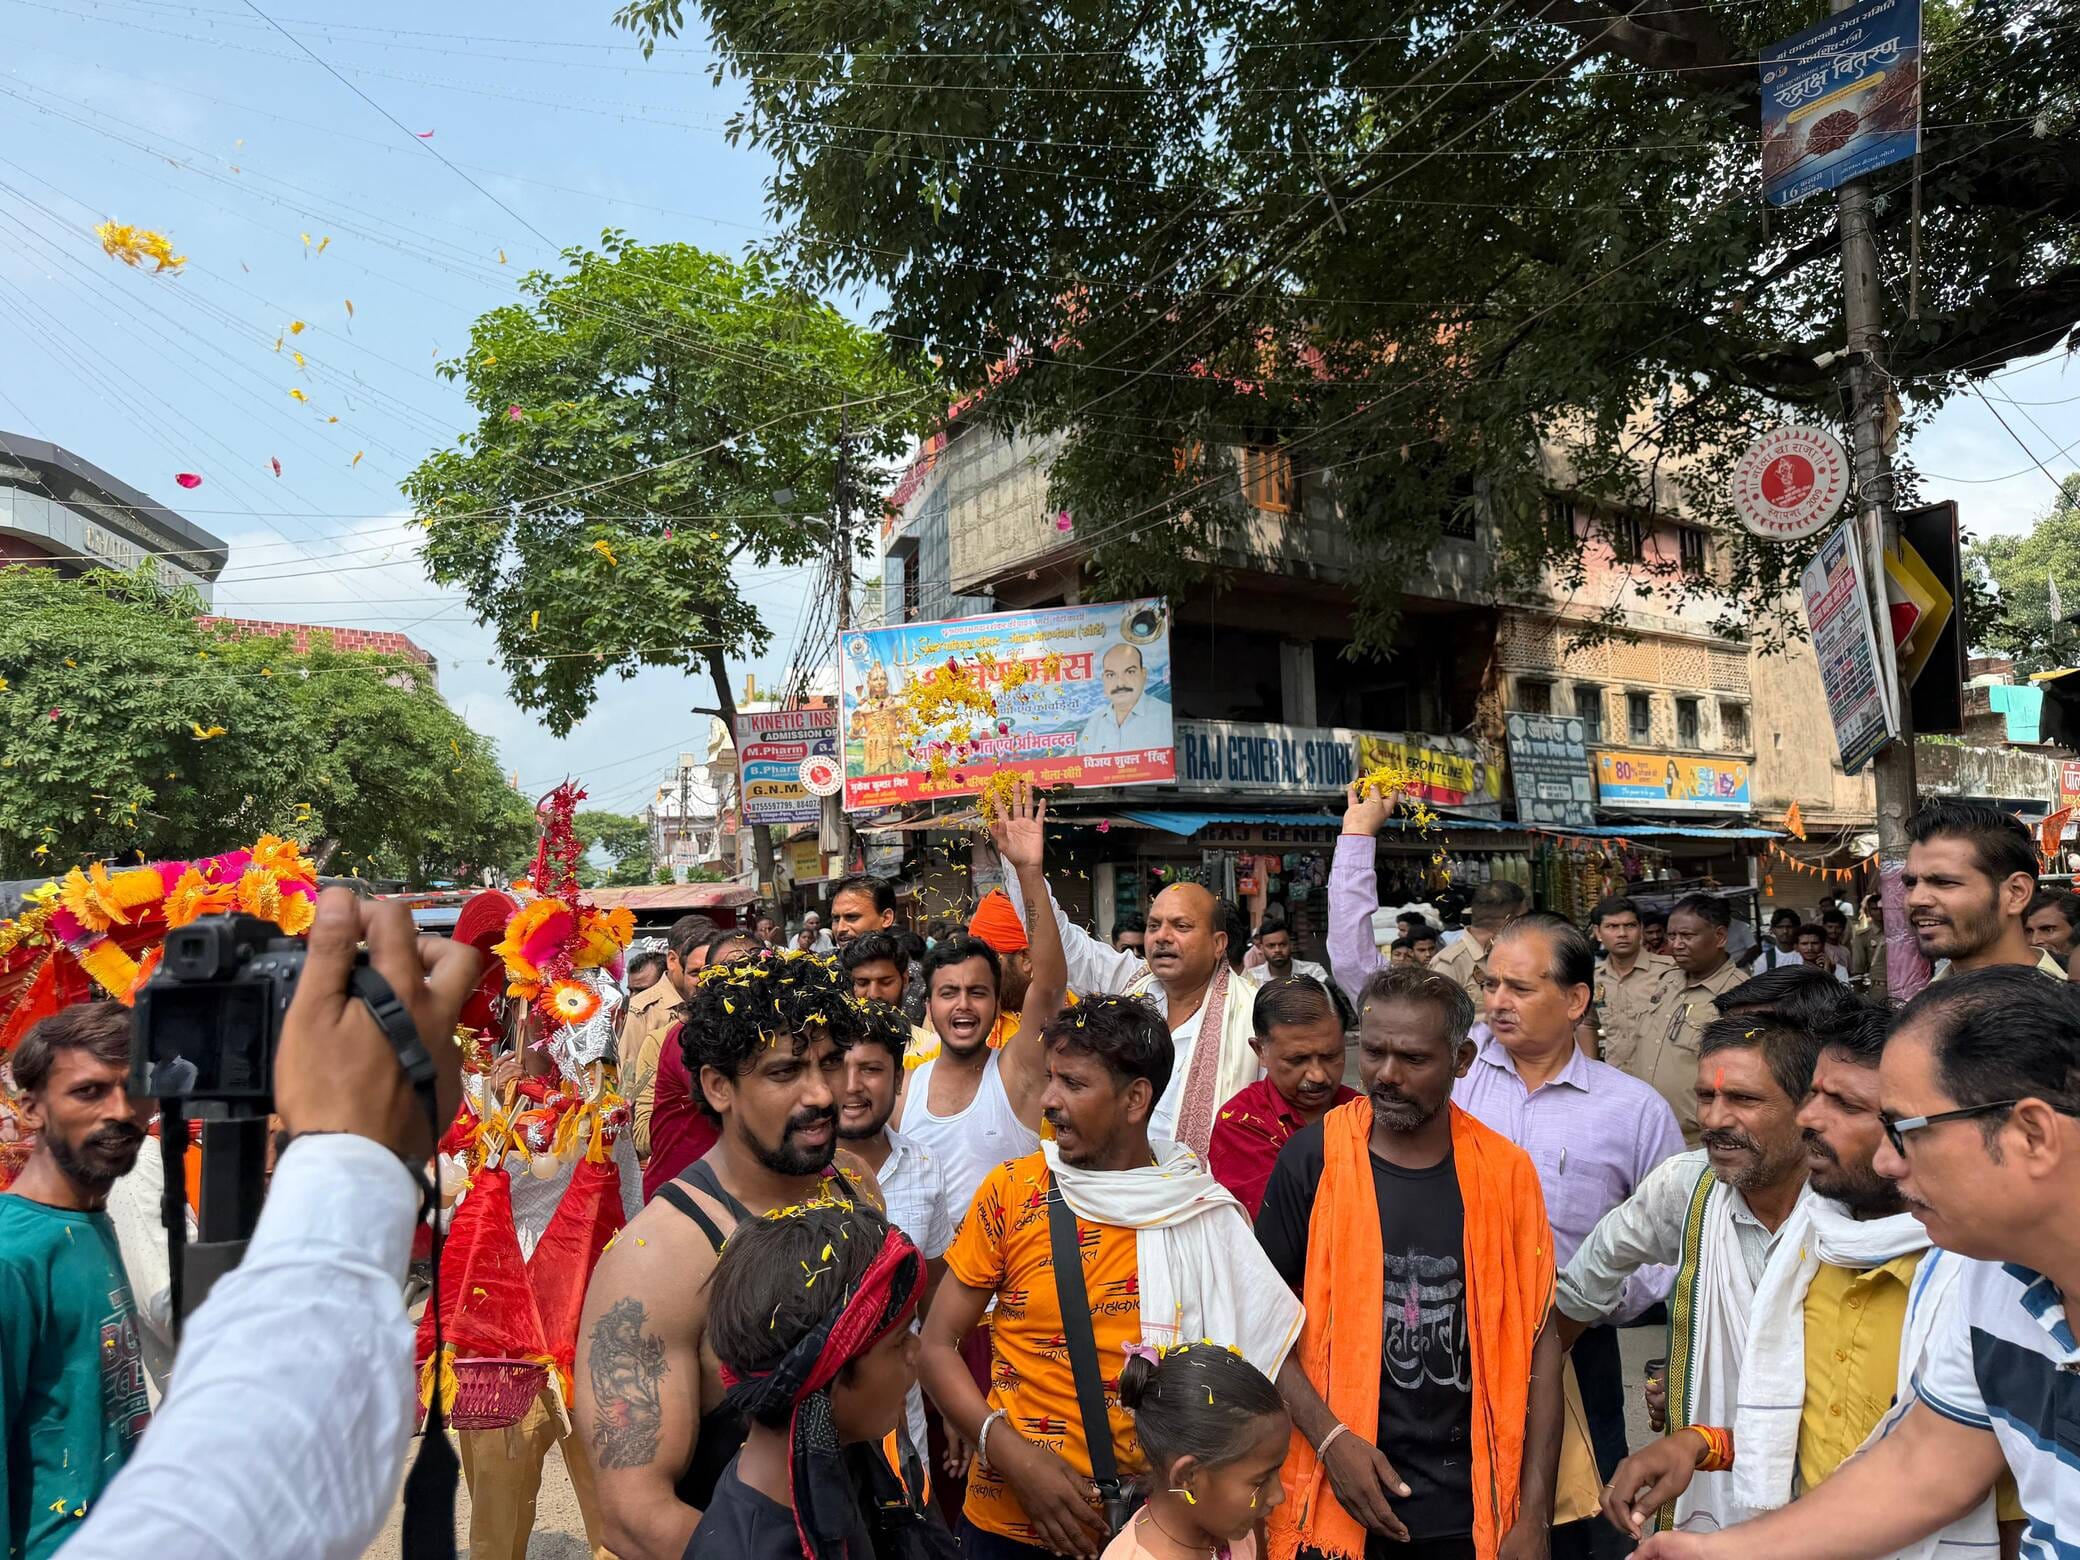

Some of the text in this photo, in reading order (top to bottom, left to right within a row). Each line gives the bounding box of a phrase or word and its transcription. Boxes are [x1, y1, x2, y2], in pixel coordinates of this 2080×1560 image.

[1773, 69, 1829, 107] रुद्राक्ष
[1831, 36, 1900, 80] वितरण
[1782, 184, 1798, 202] 16
[1792, 443, 1818, 459] राजा
[1806, 489, 1822, 508] 2009
[752, 712, 804, 732] KINETIC
[765, 729, 822, 741] ADMISSION
[1018, 729, 1078, 751] अभिनन्दन
[747, 745, 803, 756] M.Pharm
[1185, 734, 1353, 786] RAJ GENERAL STORE
[1406, 756, 1463, 779] FRONTLINE
[751, 765, 800, 775] B.Pharm
[1616, 761, 1638, 780] 80%
[753, 784, 803, 795] G.N.M.
[1201, 827, 1250, 841] RAJ
